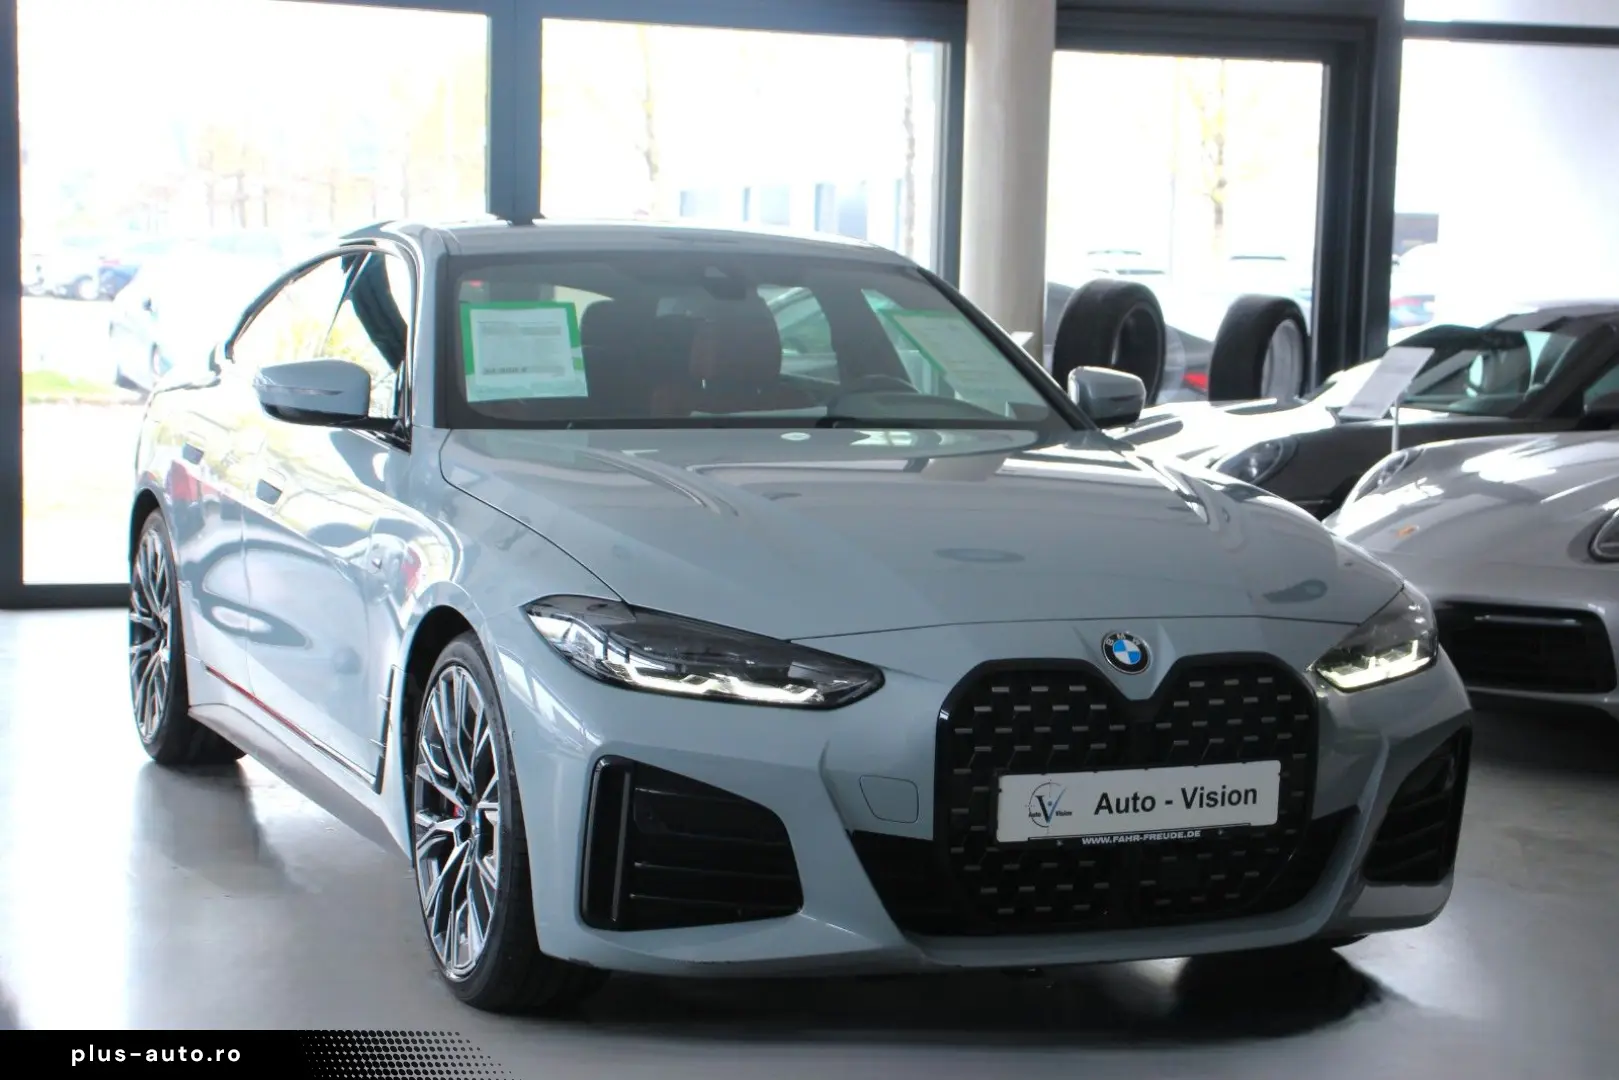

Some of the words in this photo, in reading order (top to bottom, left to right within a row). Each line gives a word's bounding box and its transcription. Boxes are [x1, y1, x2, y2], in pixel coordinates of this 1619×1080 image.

[1105, 633, 1141, 646] BMW
[1094, 792, 1156, 816] Auto
[1181, 786, 1258, 810] Vision
[1082, 830, 1201, 845] WWW.FAHR-FREUDE.DE
